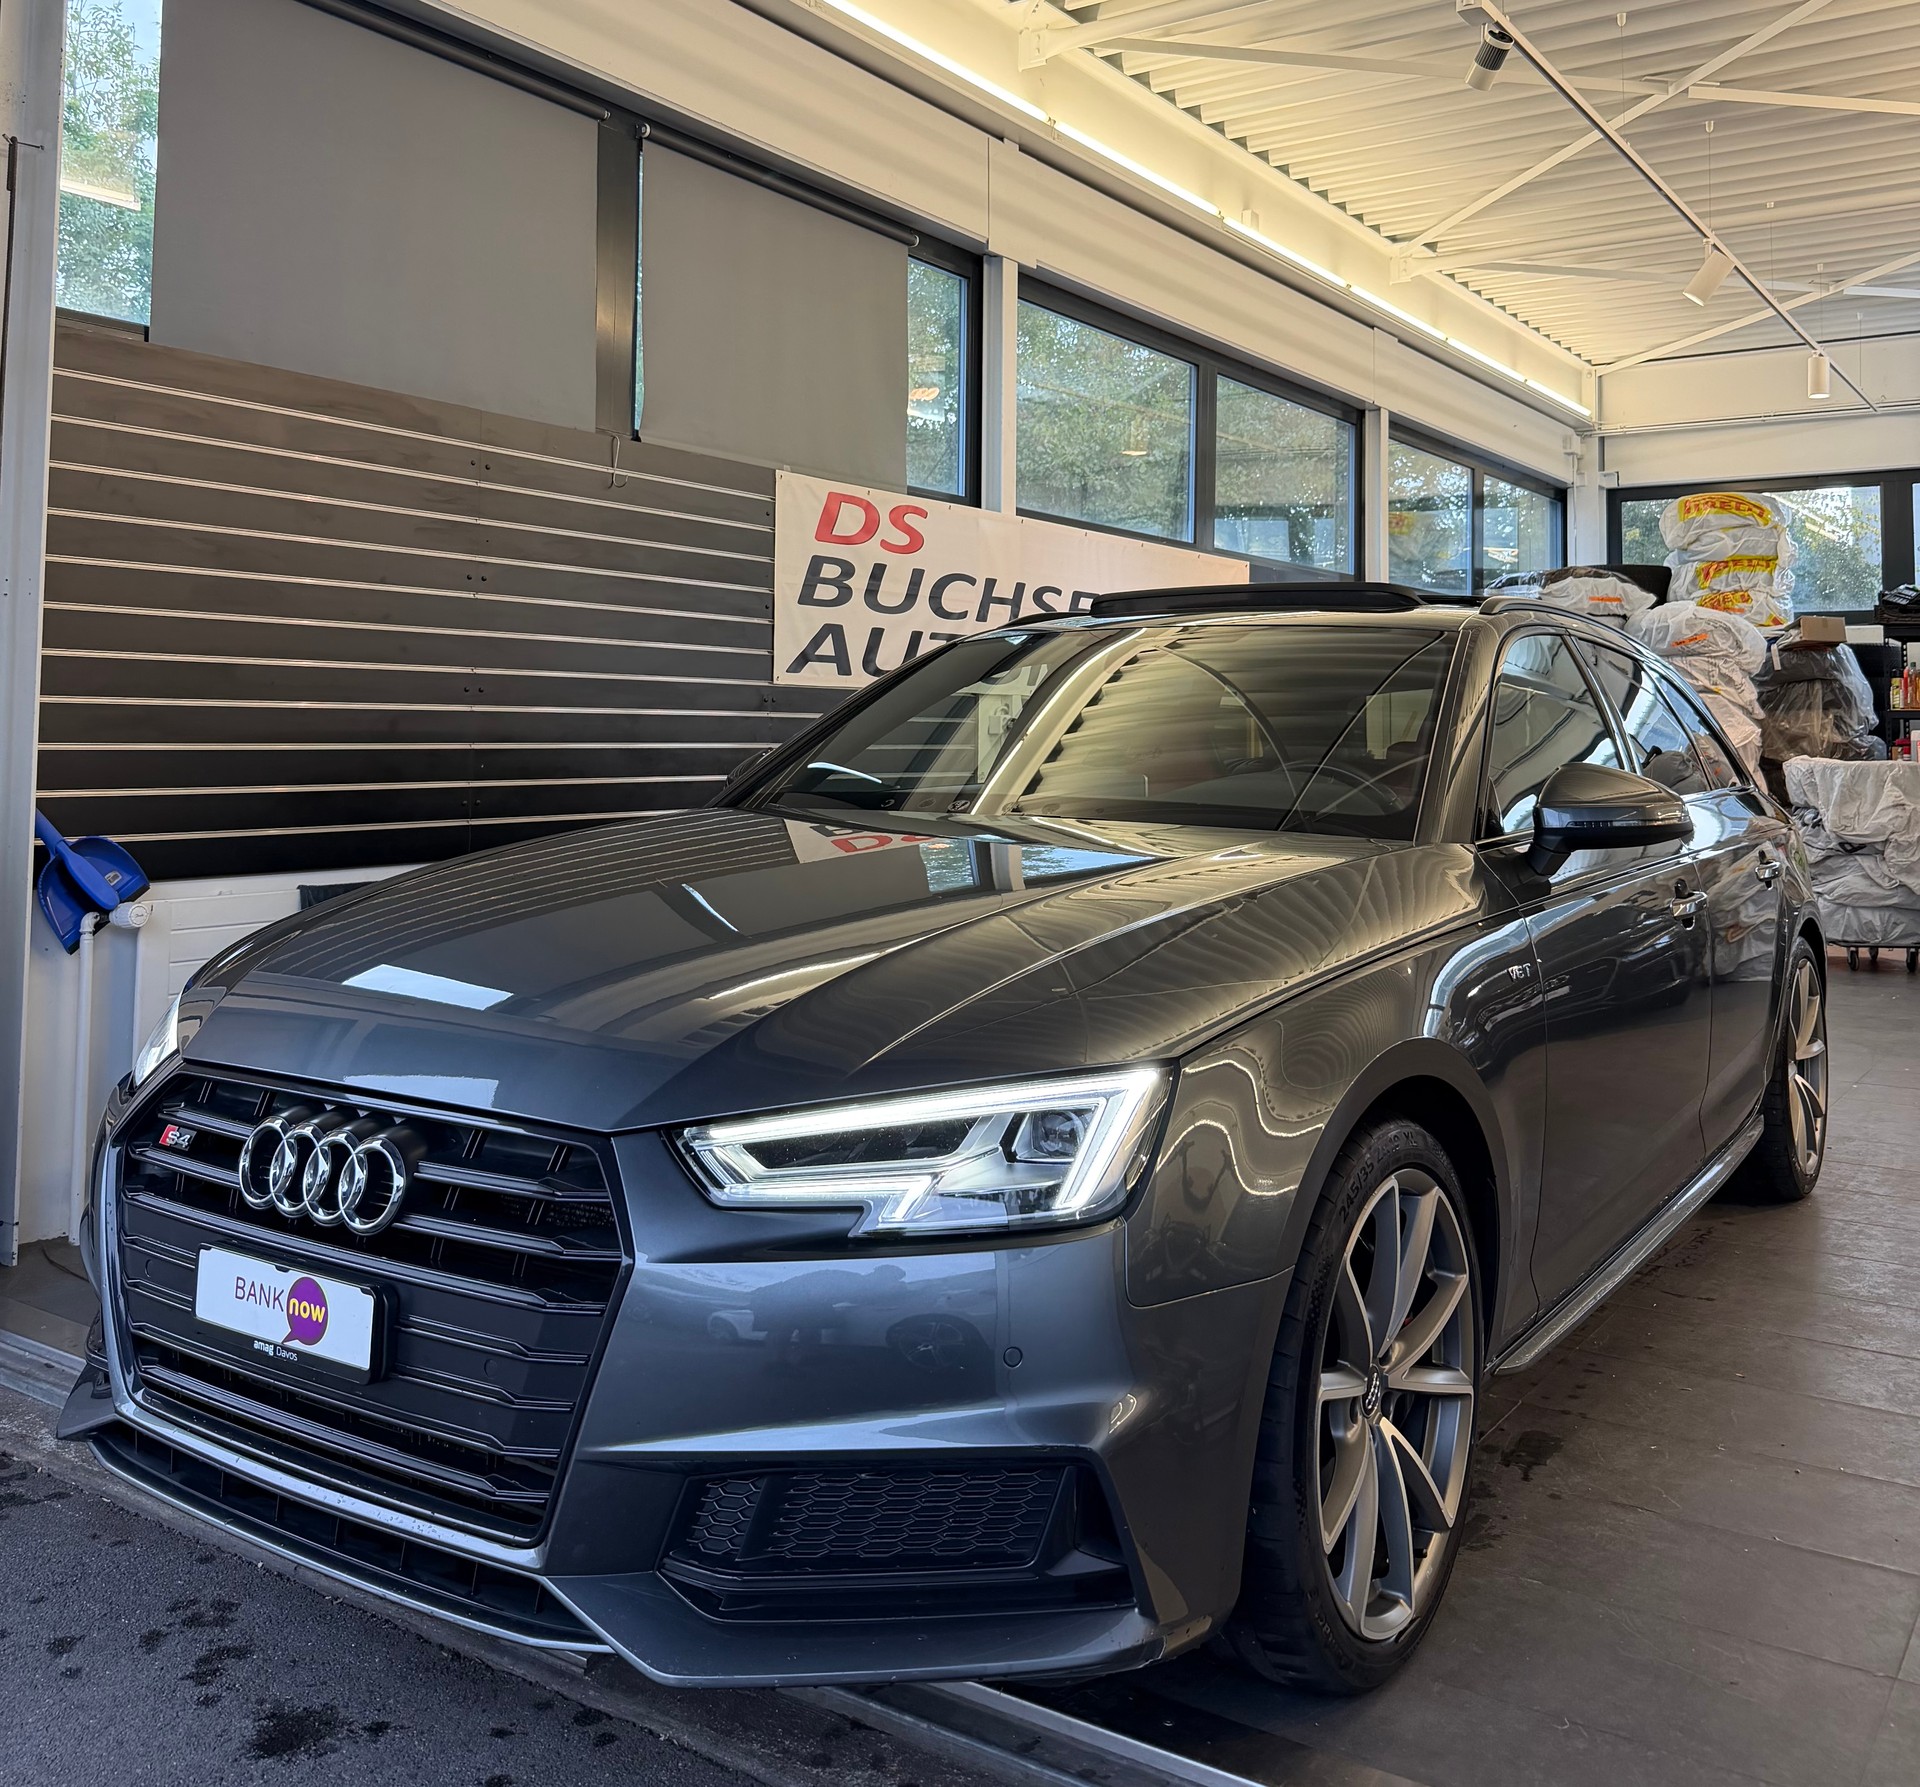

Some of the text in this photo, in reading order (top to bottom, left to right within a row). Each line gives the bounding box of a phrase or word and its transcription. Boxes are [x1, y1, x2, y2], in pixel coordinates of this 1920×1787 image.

[814, 491, 929, 555] DS
[166, 1131, 190, 1148] S4
[1339, 1162, 1374, 1224] 245/35
[235, 1276, 326, 1323] BANK now
[253, 1340, 298, 1361] amag Davos
